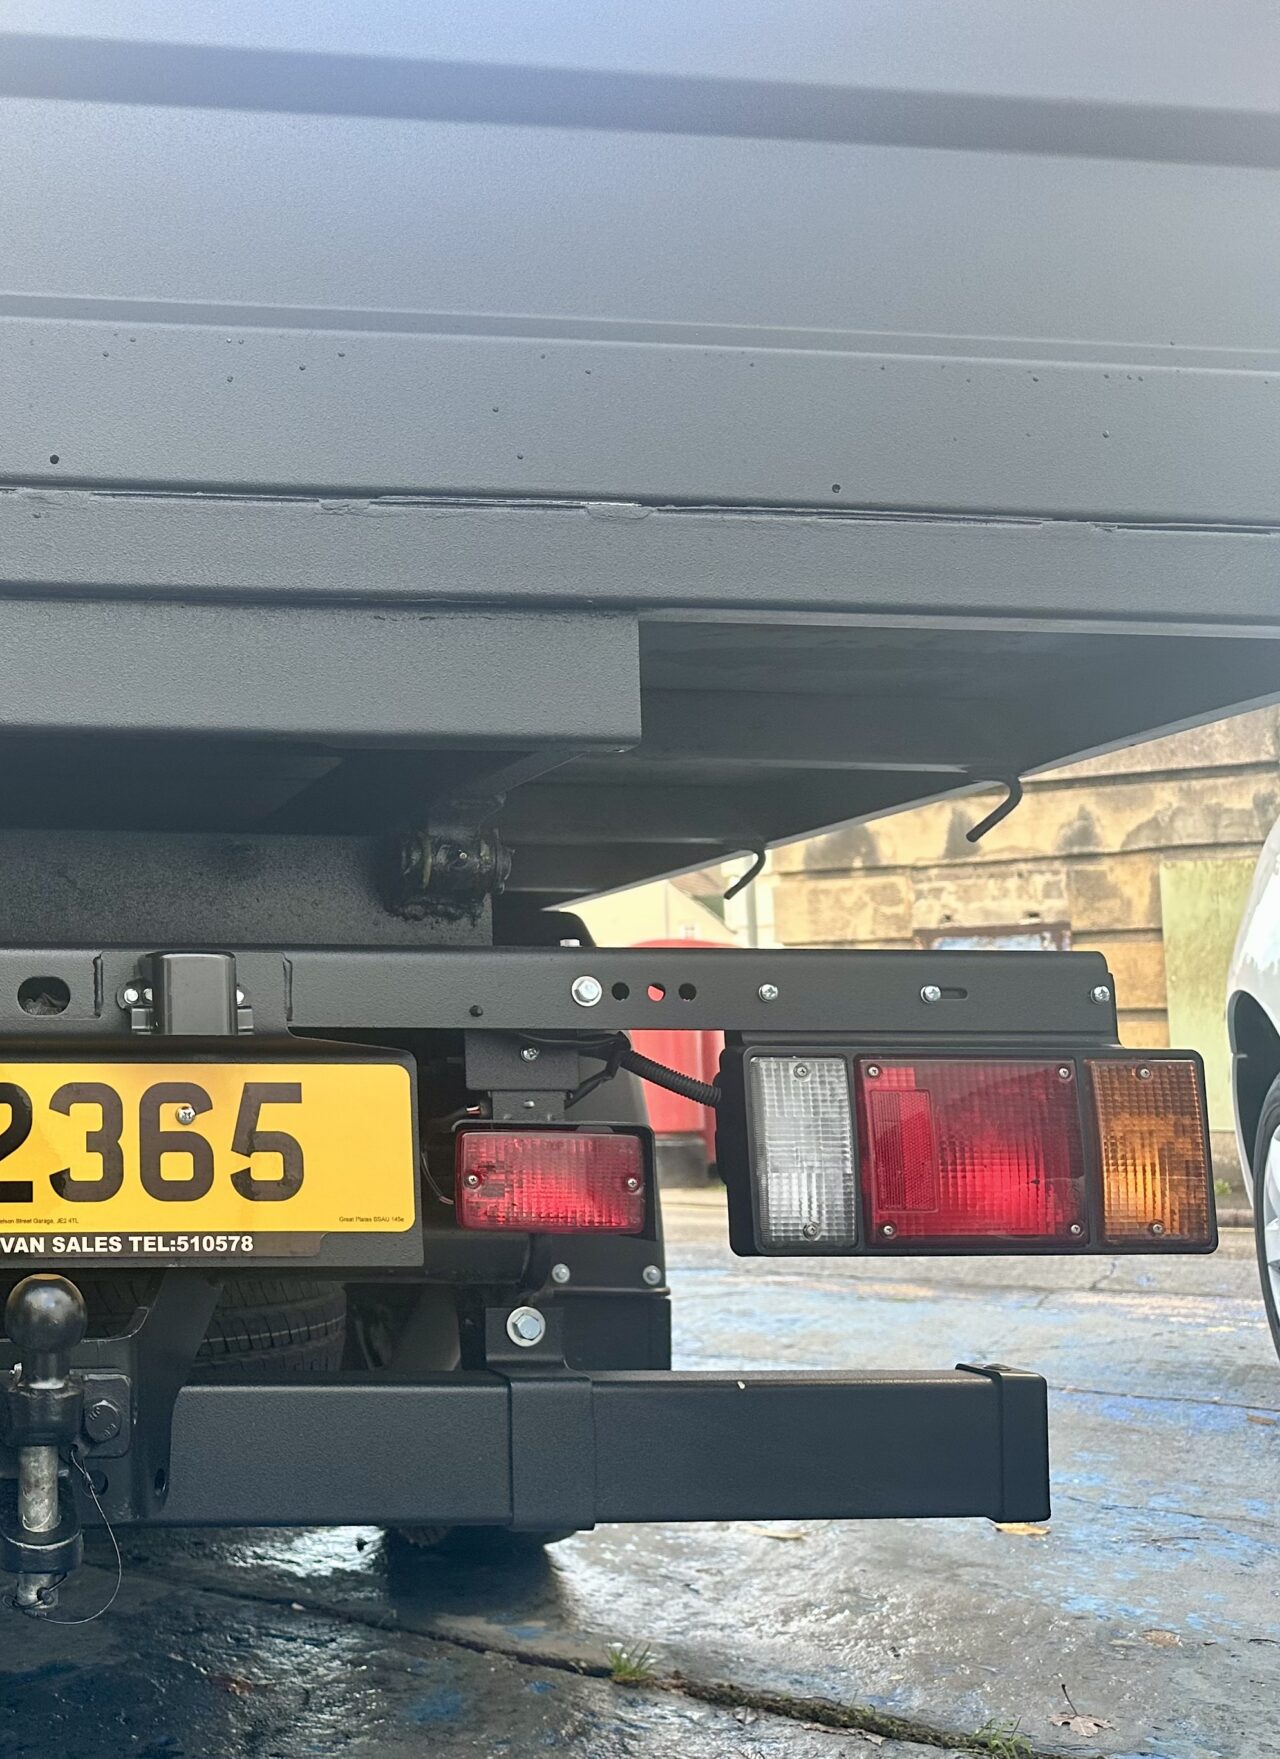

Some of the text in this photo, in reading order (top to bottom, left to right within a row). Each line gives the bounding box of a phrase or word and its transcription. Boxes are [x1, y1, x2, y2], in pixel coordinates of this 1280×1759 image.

[0, 1237, 45, 1254] VAN
[52, 1236, 122, 1253] SALES
[128, 1235, 254, 1252] TEL:510578
